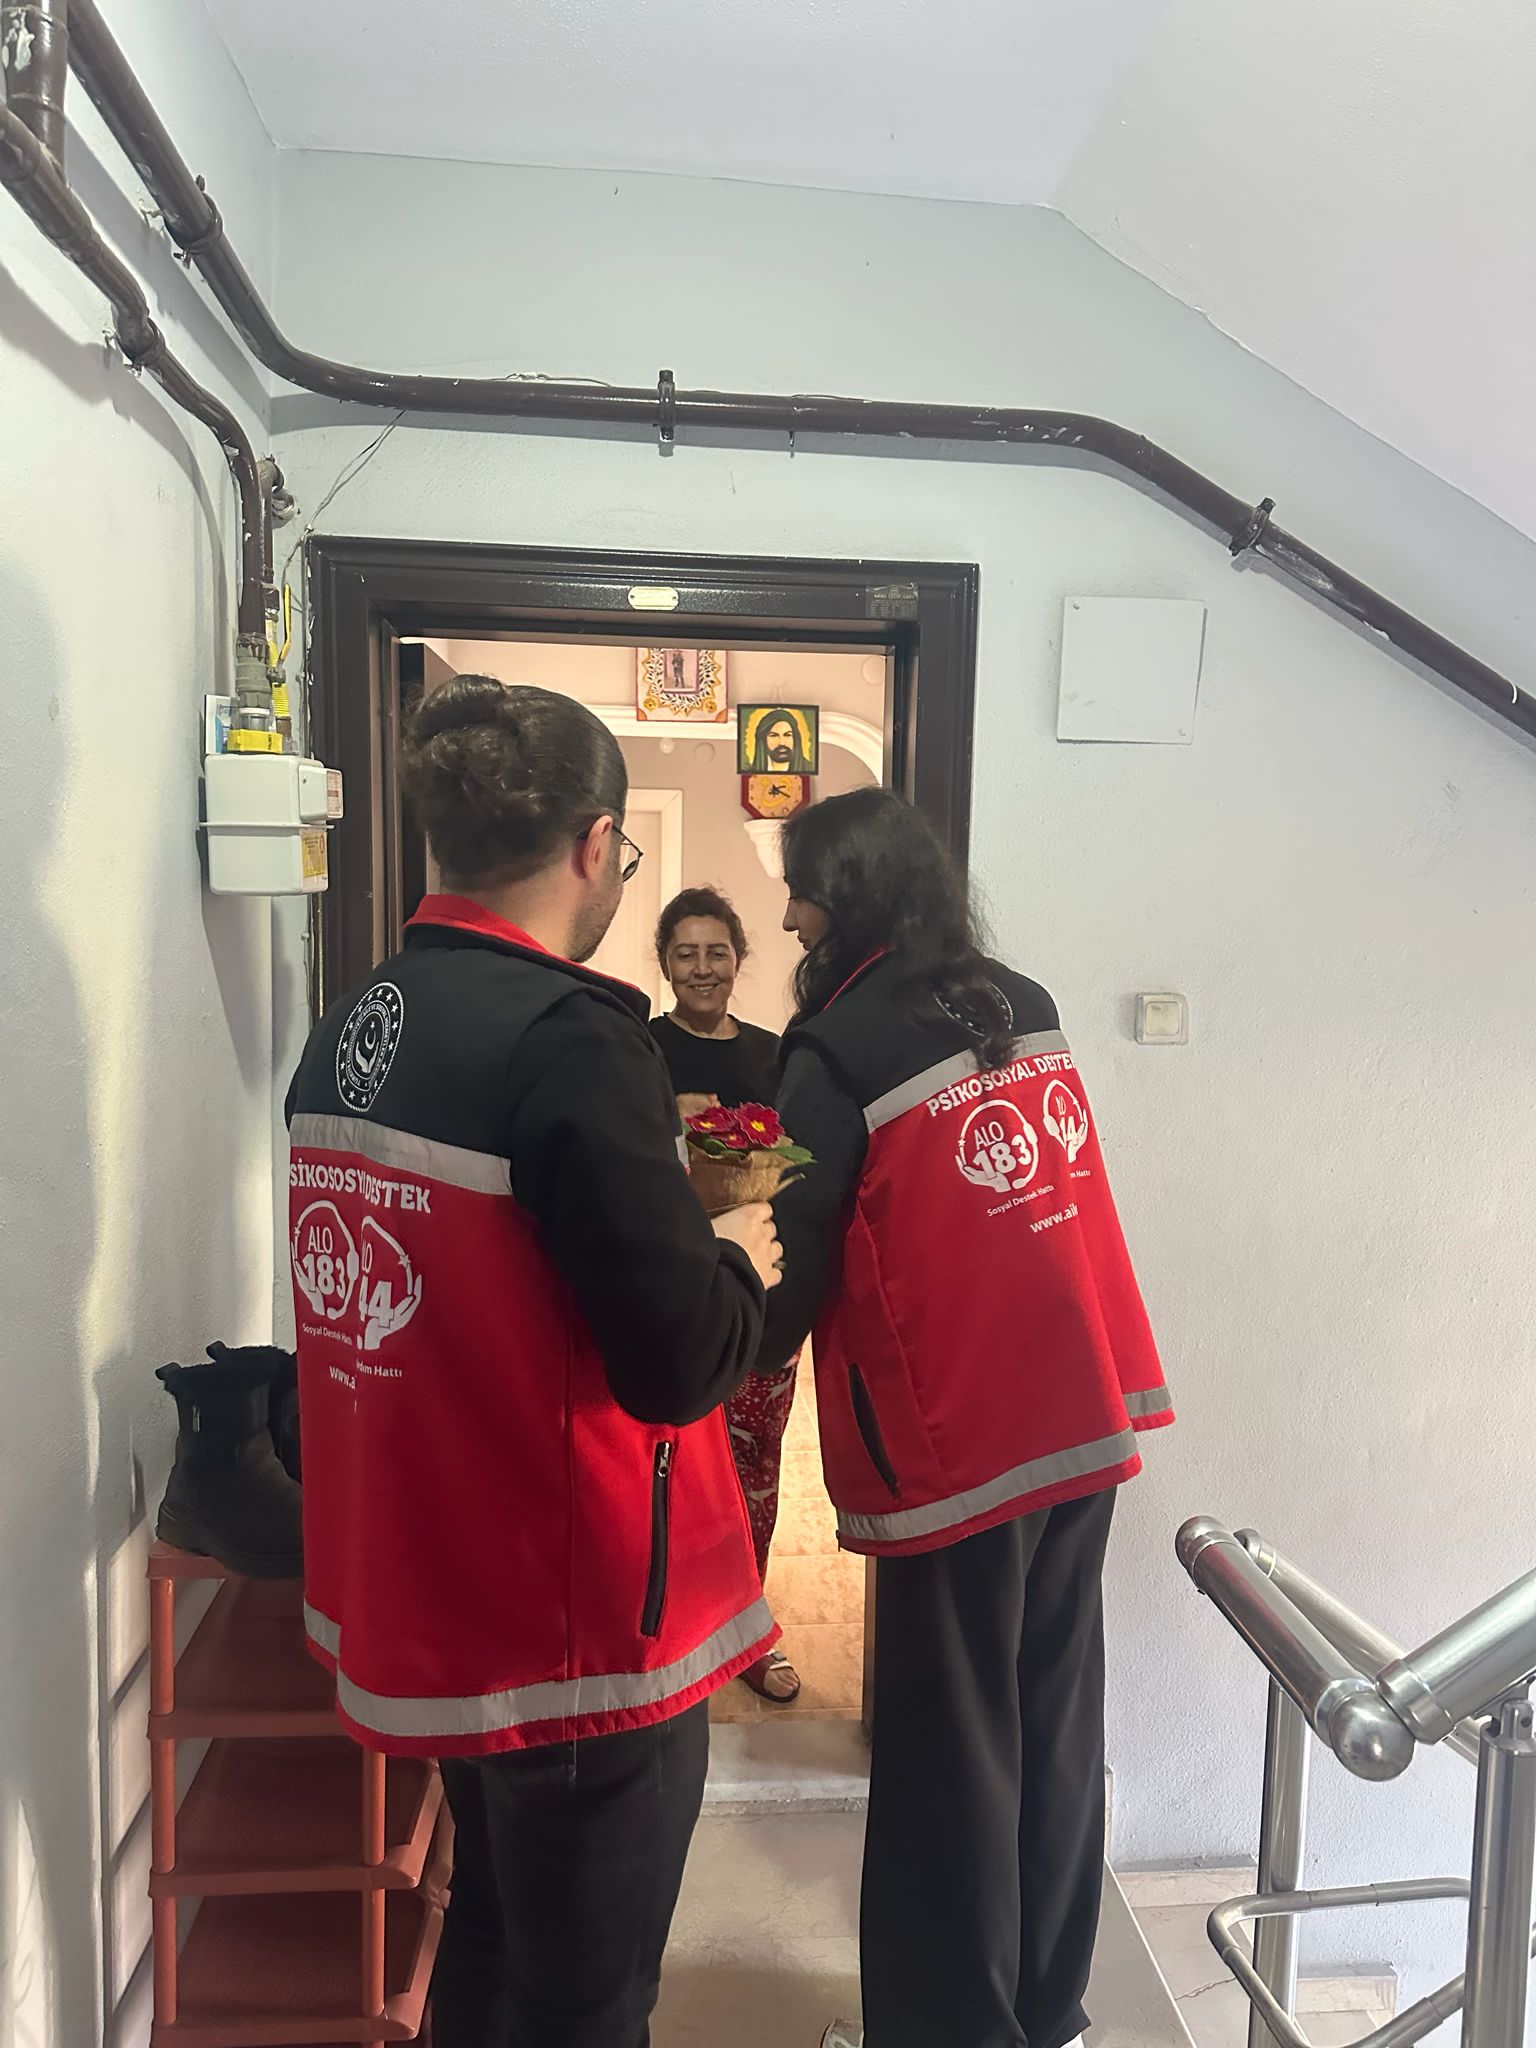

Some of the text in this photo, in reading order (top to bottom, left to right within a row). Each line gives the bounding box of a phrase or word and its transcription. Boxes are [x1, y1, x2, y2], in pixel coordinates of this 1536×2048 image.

[973, 1121, 1004, 1150] ALO
[972, 1134, 1032, 1180] 183
[986, 1199, 1013, 1217] Sosyal
[308, 1225, 333, 1254] ALO
[302, 1253, 346, 1300] 183
